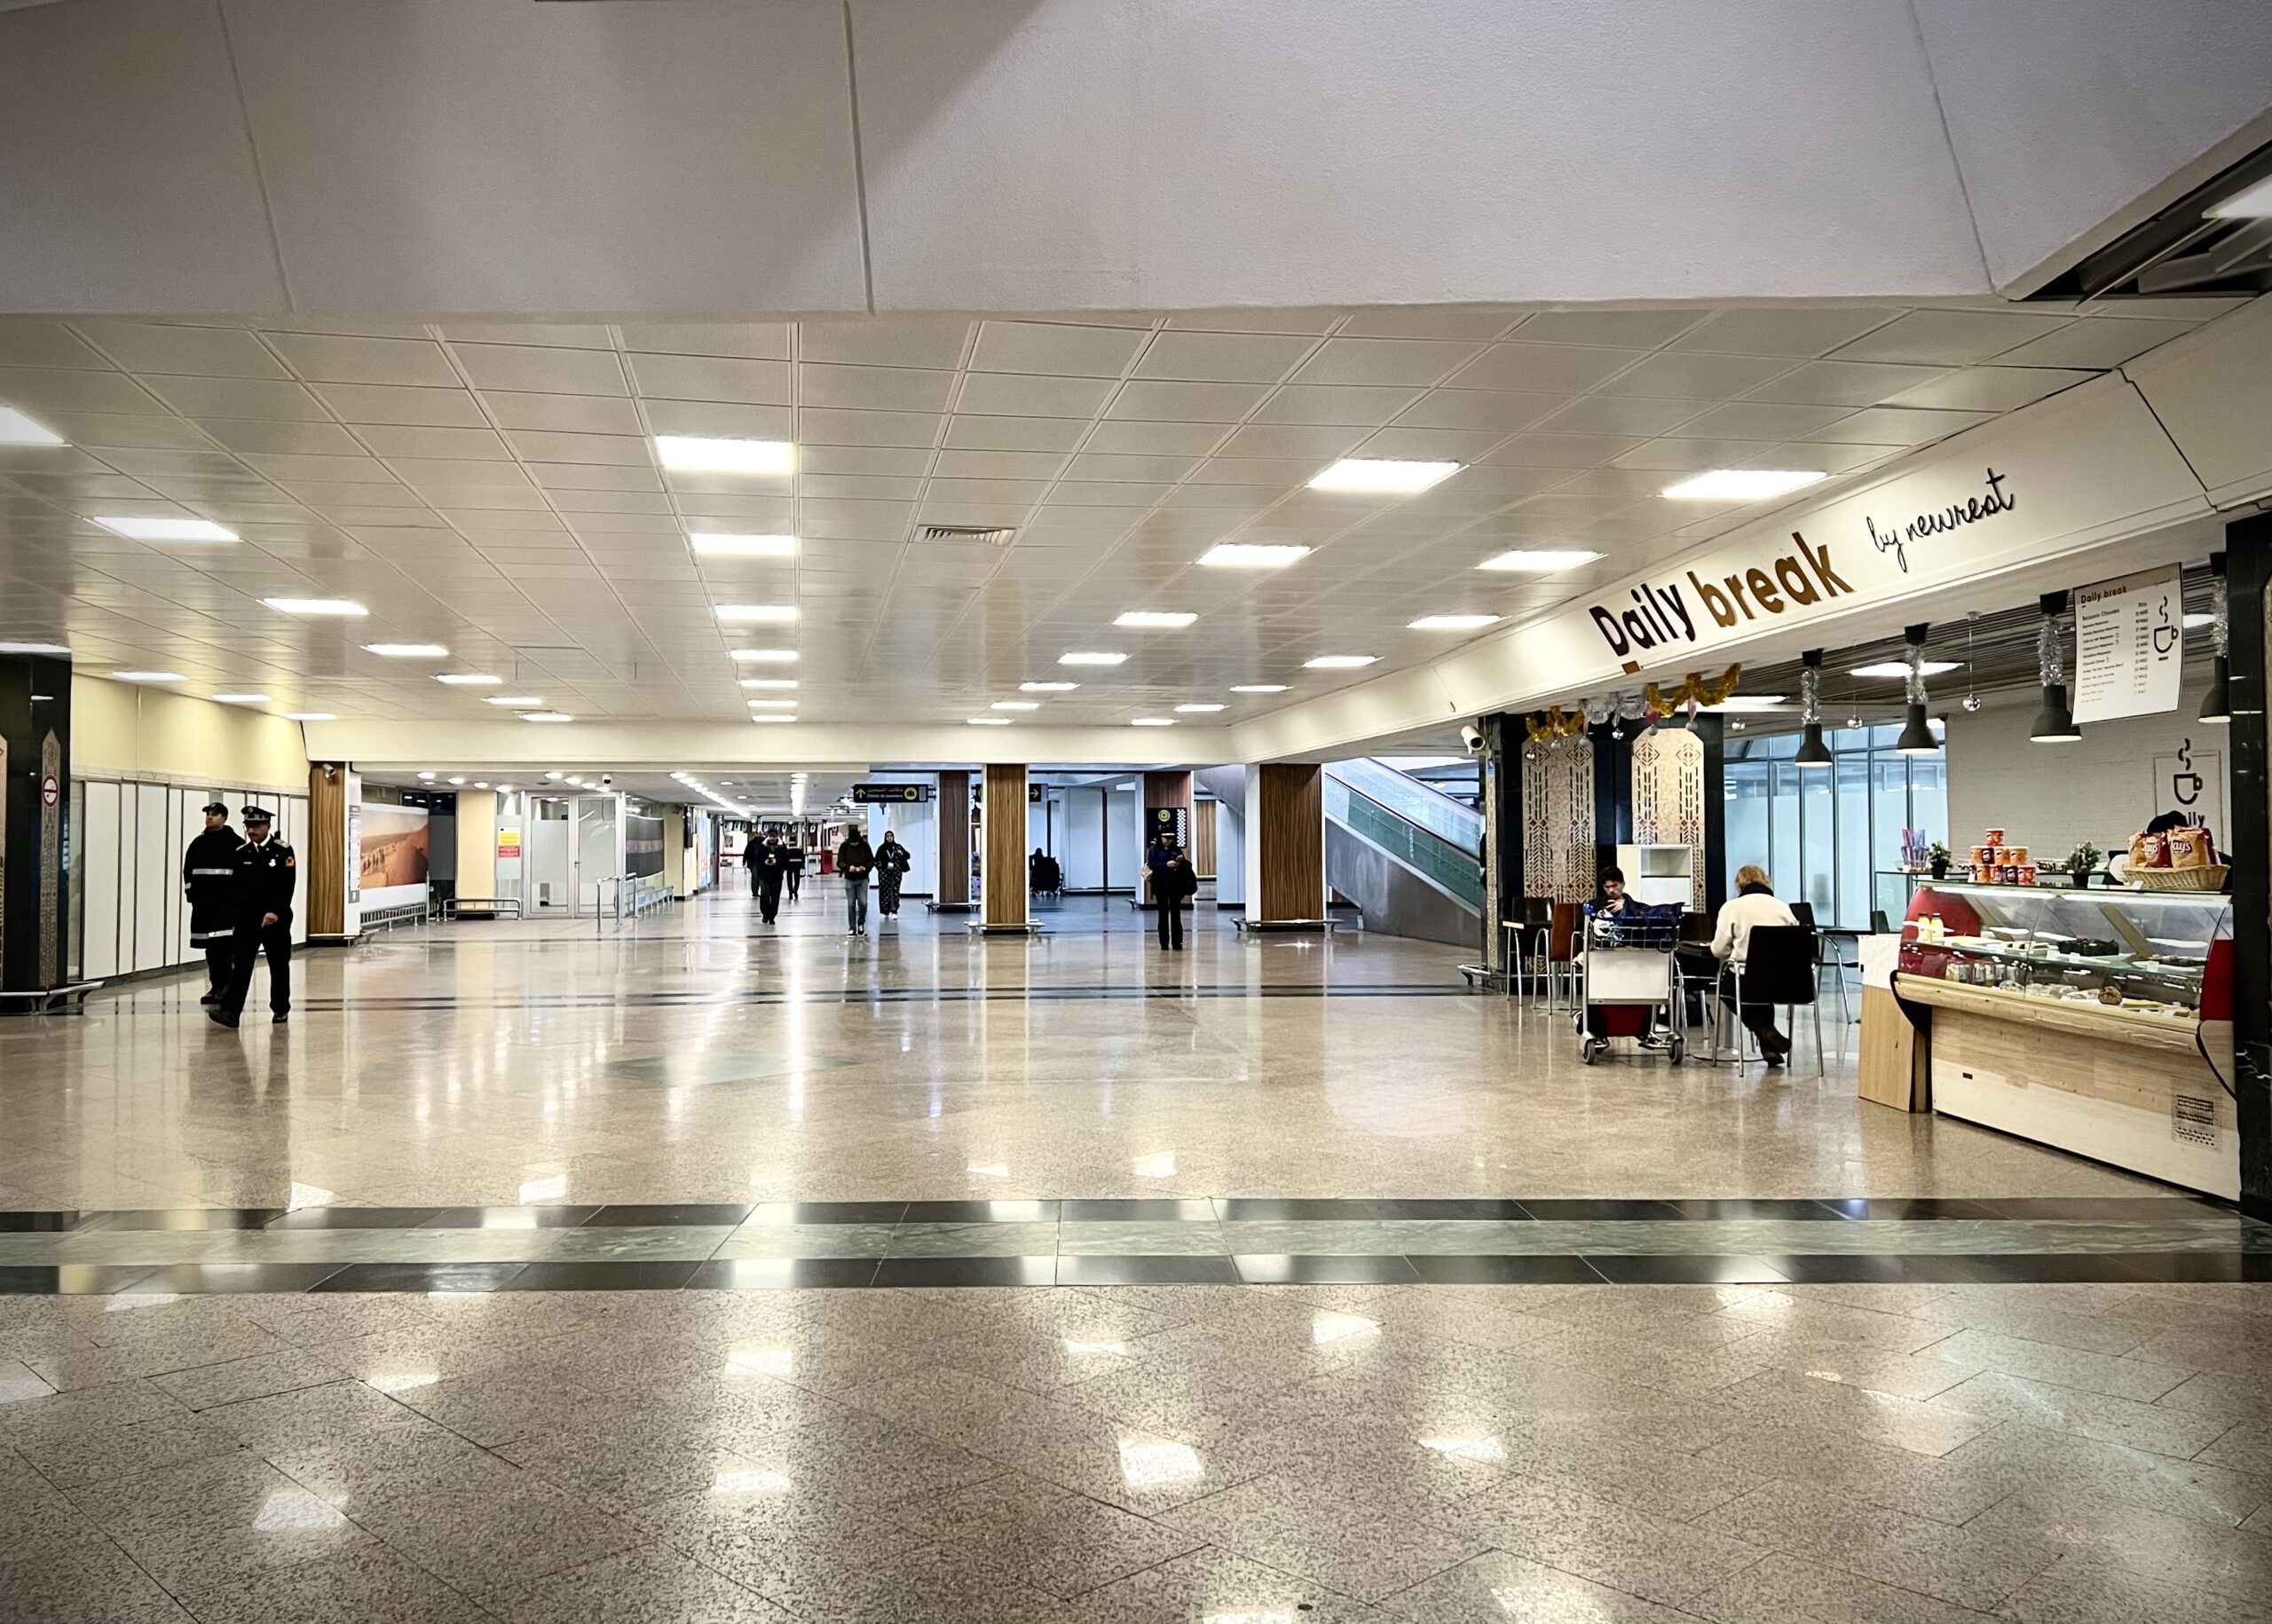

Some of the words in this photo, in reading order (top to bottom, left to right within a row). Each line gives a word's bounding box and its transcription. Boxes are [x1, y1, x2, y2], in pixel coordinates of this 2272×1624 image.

[1588, 583, 1696, 657] Daily
[1686, 531, 1857, 627] break
[1866, 516, 1908, 573] by
[1905, 467, 2015, 542] newrest
[2080, 590, 2102, 603] Daily
[2103, 584, 2127, 598] break
